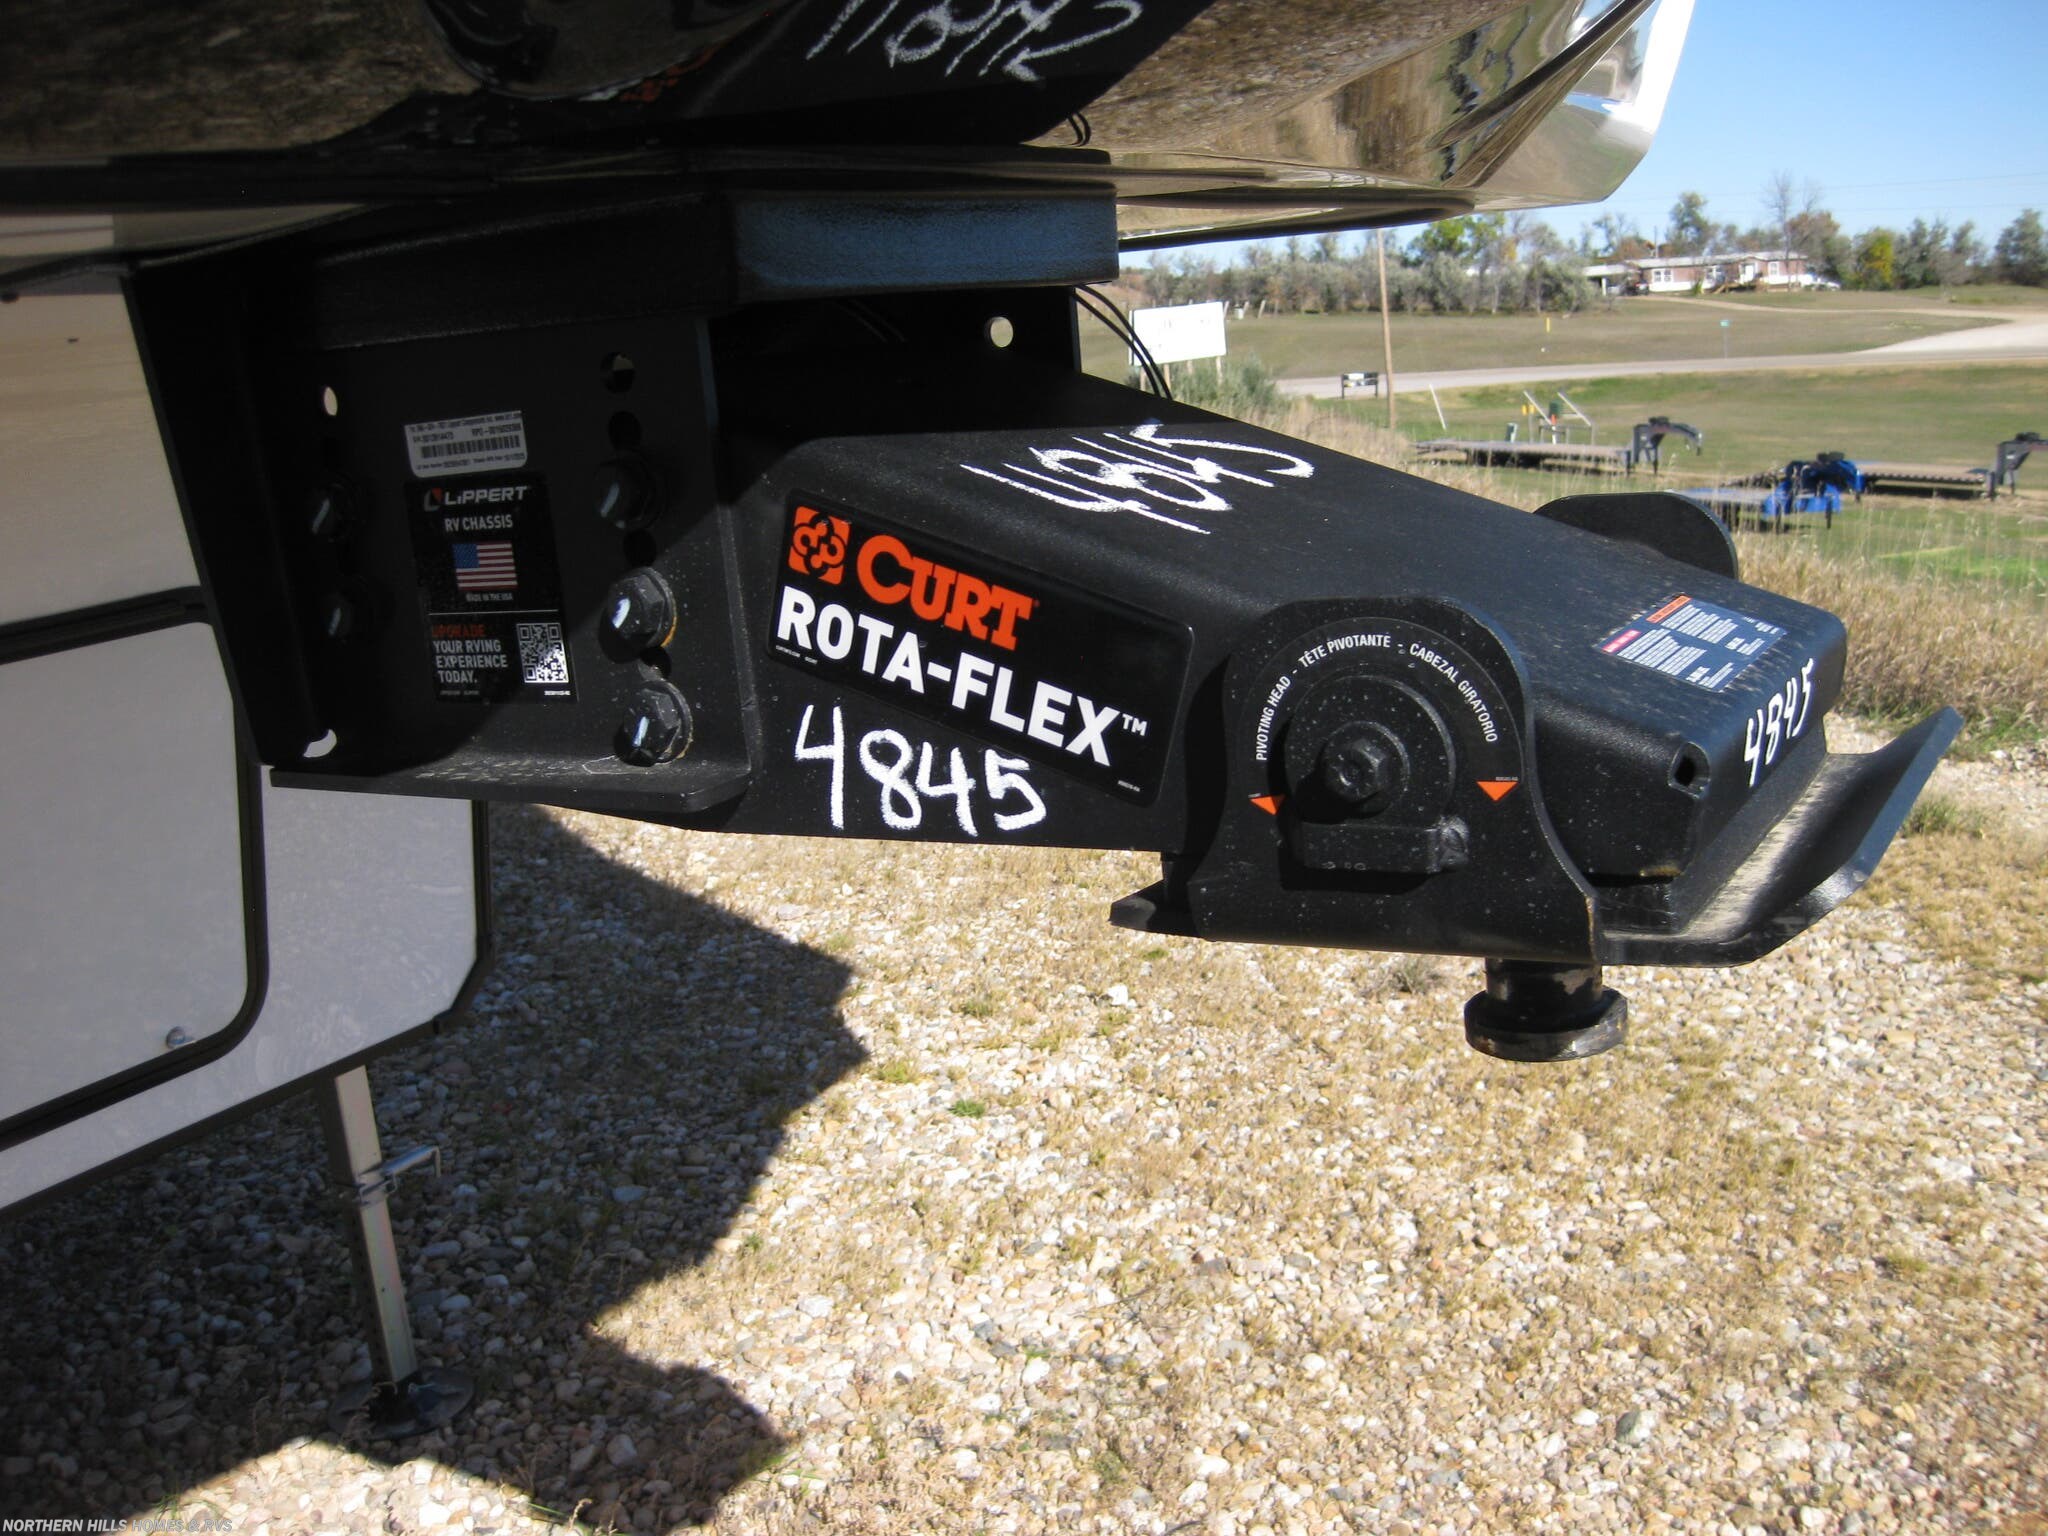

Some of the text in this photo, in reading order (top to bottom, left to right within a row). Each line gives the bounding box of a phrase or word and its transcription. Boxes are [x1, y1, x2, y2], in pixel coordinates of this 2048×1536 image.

[444, 514, 513, 532] RV CHASSIS
[959, 422, 1314, 534] 4845
[433, 640, 501, 654] YOUR RVING
[857, 535, 1034, 651] CURT
[436, 654, 508, 668] EXPERIENCE
[438, 670, 478, 684] TODAY.
[1255, 707, 1276, 761] PIVOTING
[1267, 676, 1291, 709] HEAD
[1298, 646, 1328, 668] TÊTE
[1327, 634, 1391, 653] PIVOTANTE
[1409, 643, 1457, 684] CABEZAL
[1457, 680, 1499, 744] GIRATORIO
[795, 705, 1046, 837] 4845
[1744, 658, 1814, 787] 4845
